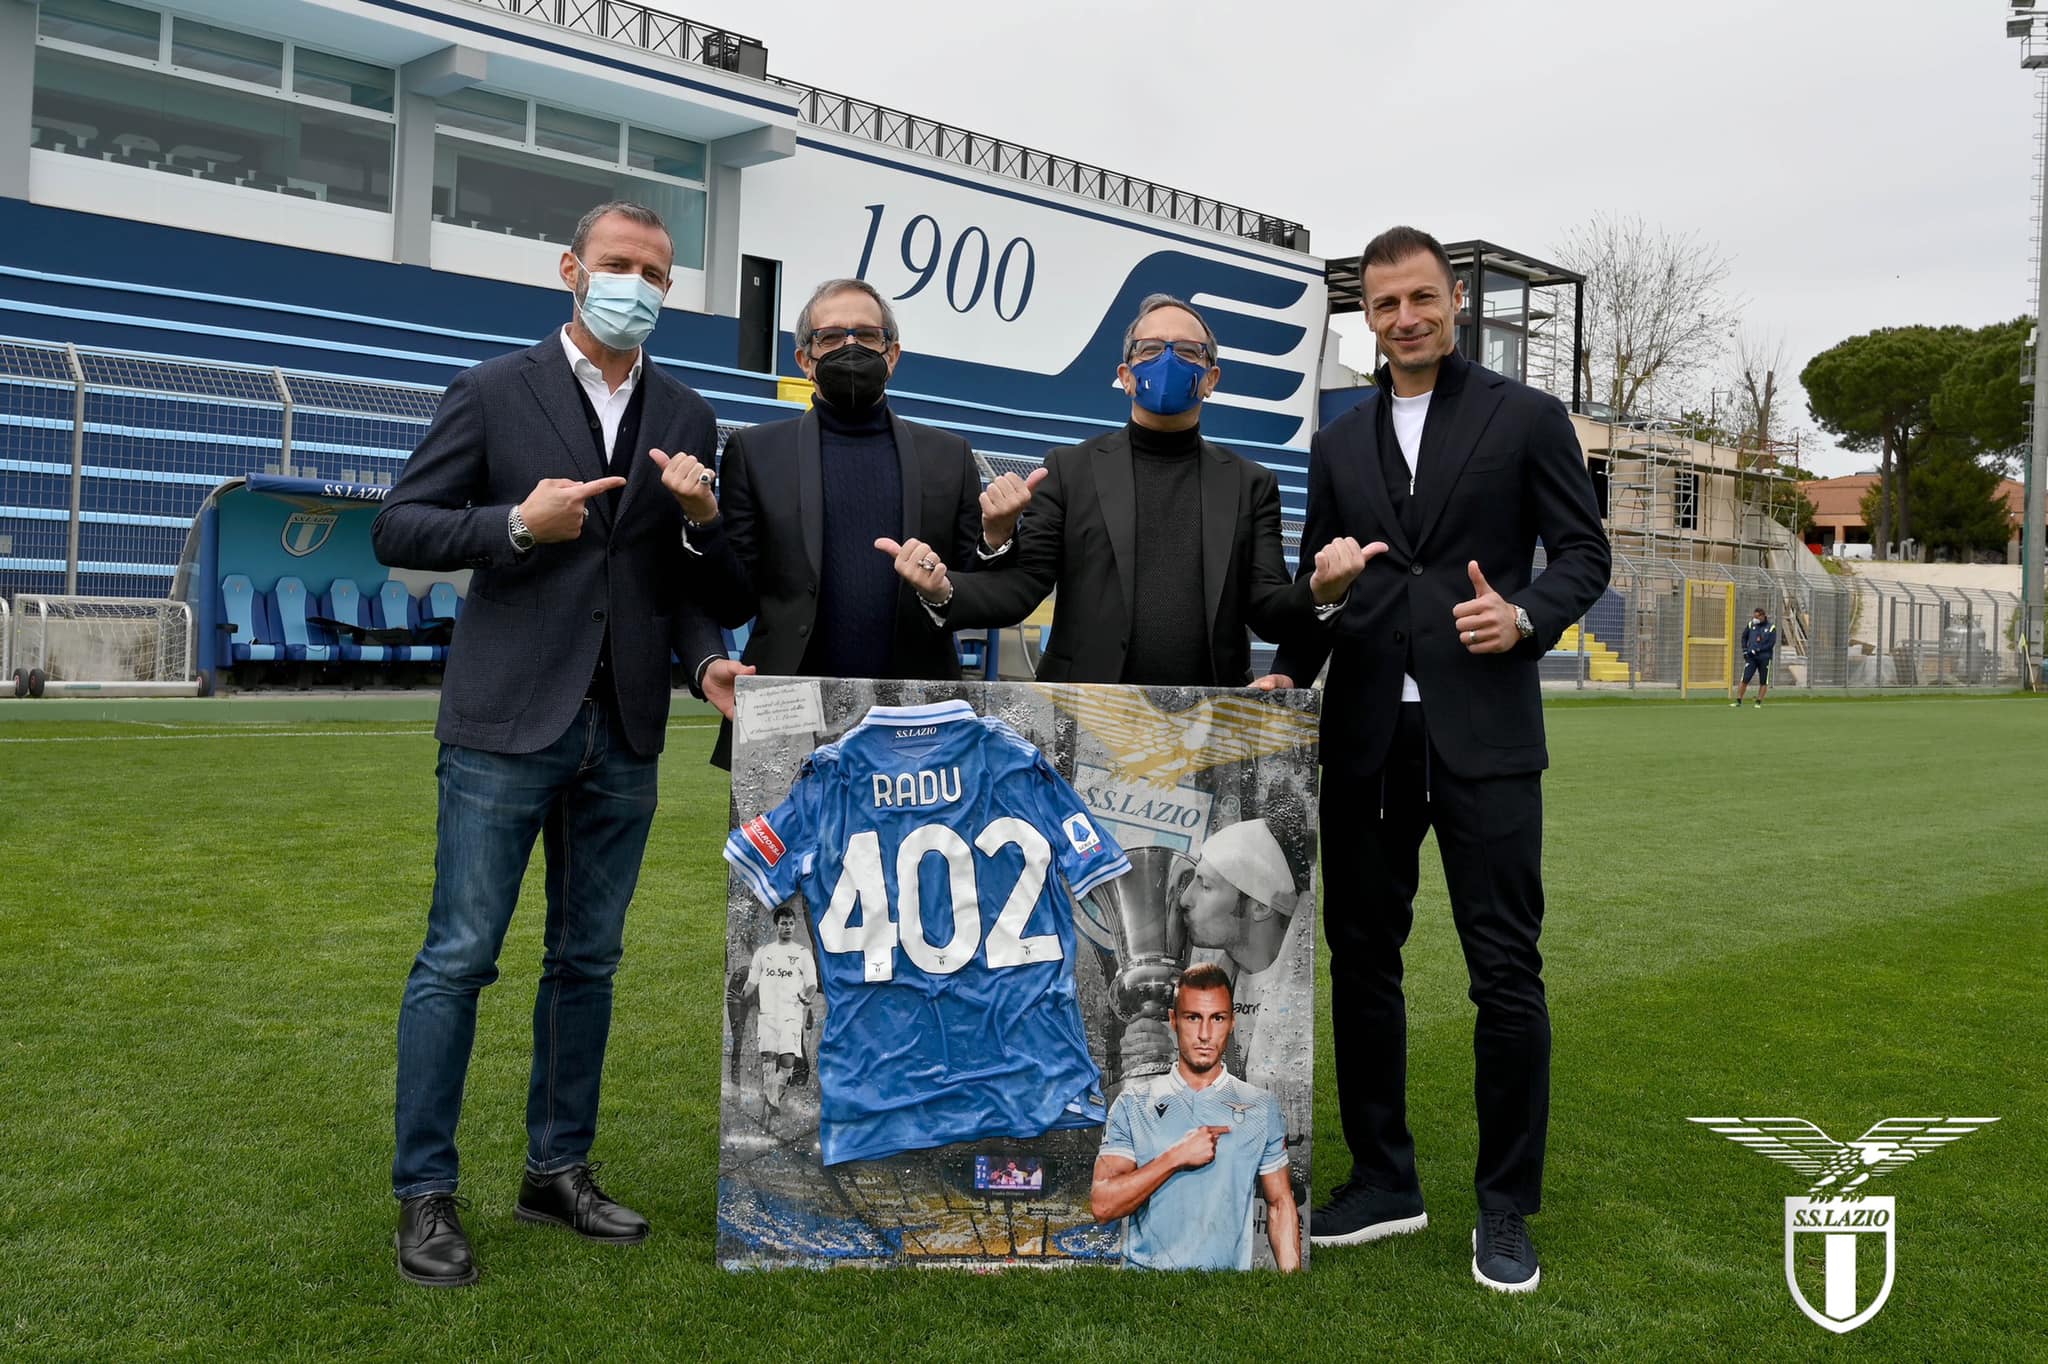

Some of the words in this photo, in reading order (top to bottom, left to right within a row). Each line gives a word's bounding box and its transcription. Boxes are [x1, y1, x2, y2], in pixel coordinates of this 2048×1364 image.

[855, 204, 1035, 321] 1900
[895, 727, 937, 738] S.S.LAZIO
[872, 766, 962, 808] RADU
[1086, 786, 1201, 828] S.S.LAZIO
[818, 816, 1064, 982] 402
